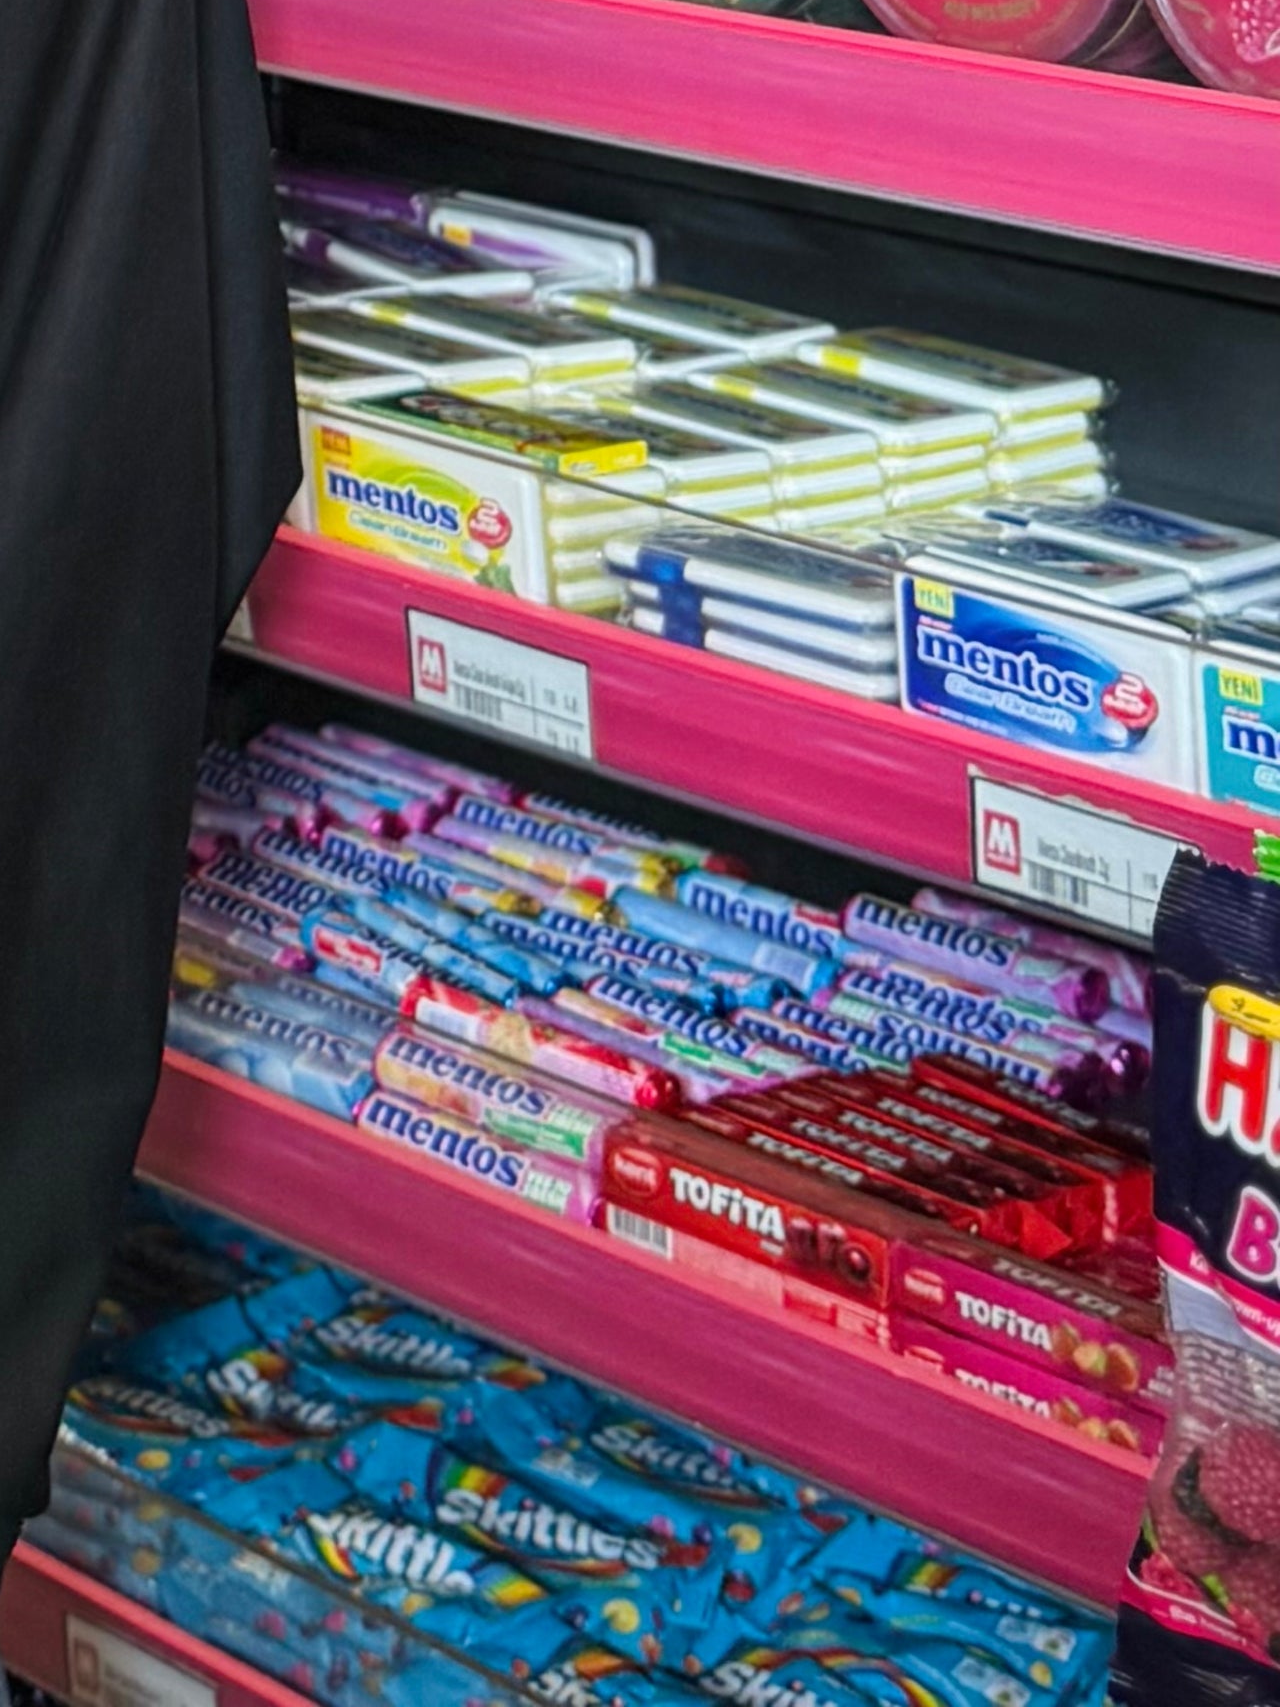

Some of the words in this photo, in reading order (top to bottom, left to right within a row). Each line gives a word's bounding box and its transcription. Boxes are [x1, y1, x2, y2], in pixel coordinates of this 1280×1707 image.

[326, 468, 460, 533] mentos
[921, 632, 1090, 709] mentos
[460, 797, 593, 855] mentos
[324, 831, 455, 899] mentos
[543, 907, 706, 976] mentos
[691, 884, 835, 960] mentos
[856, 898, 1017, 967] mentos
[596, 975, 749, 1058] mentos
[781, 997, 917, 1062] mento
[386, 1035, 552, 1116] mentos
[364, 1097, 525, 1188] mentos
[434, 1486, 662, 1571] Skittles
